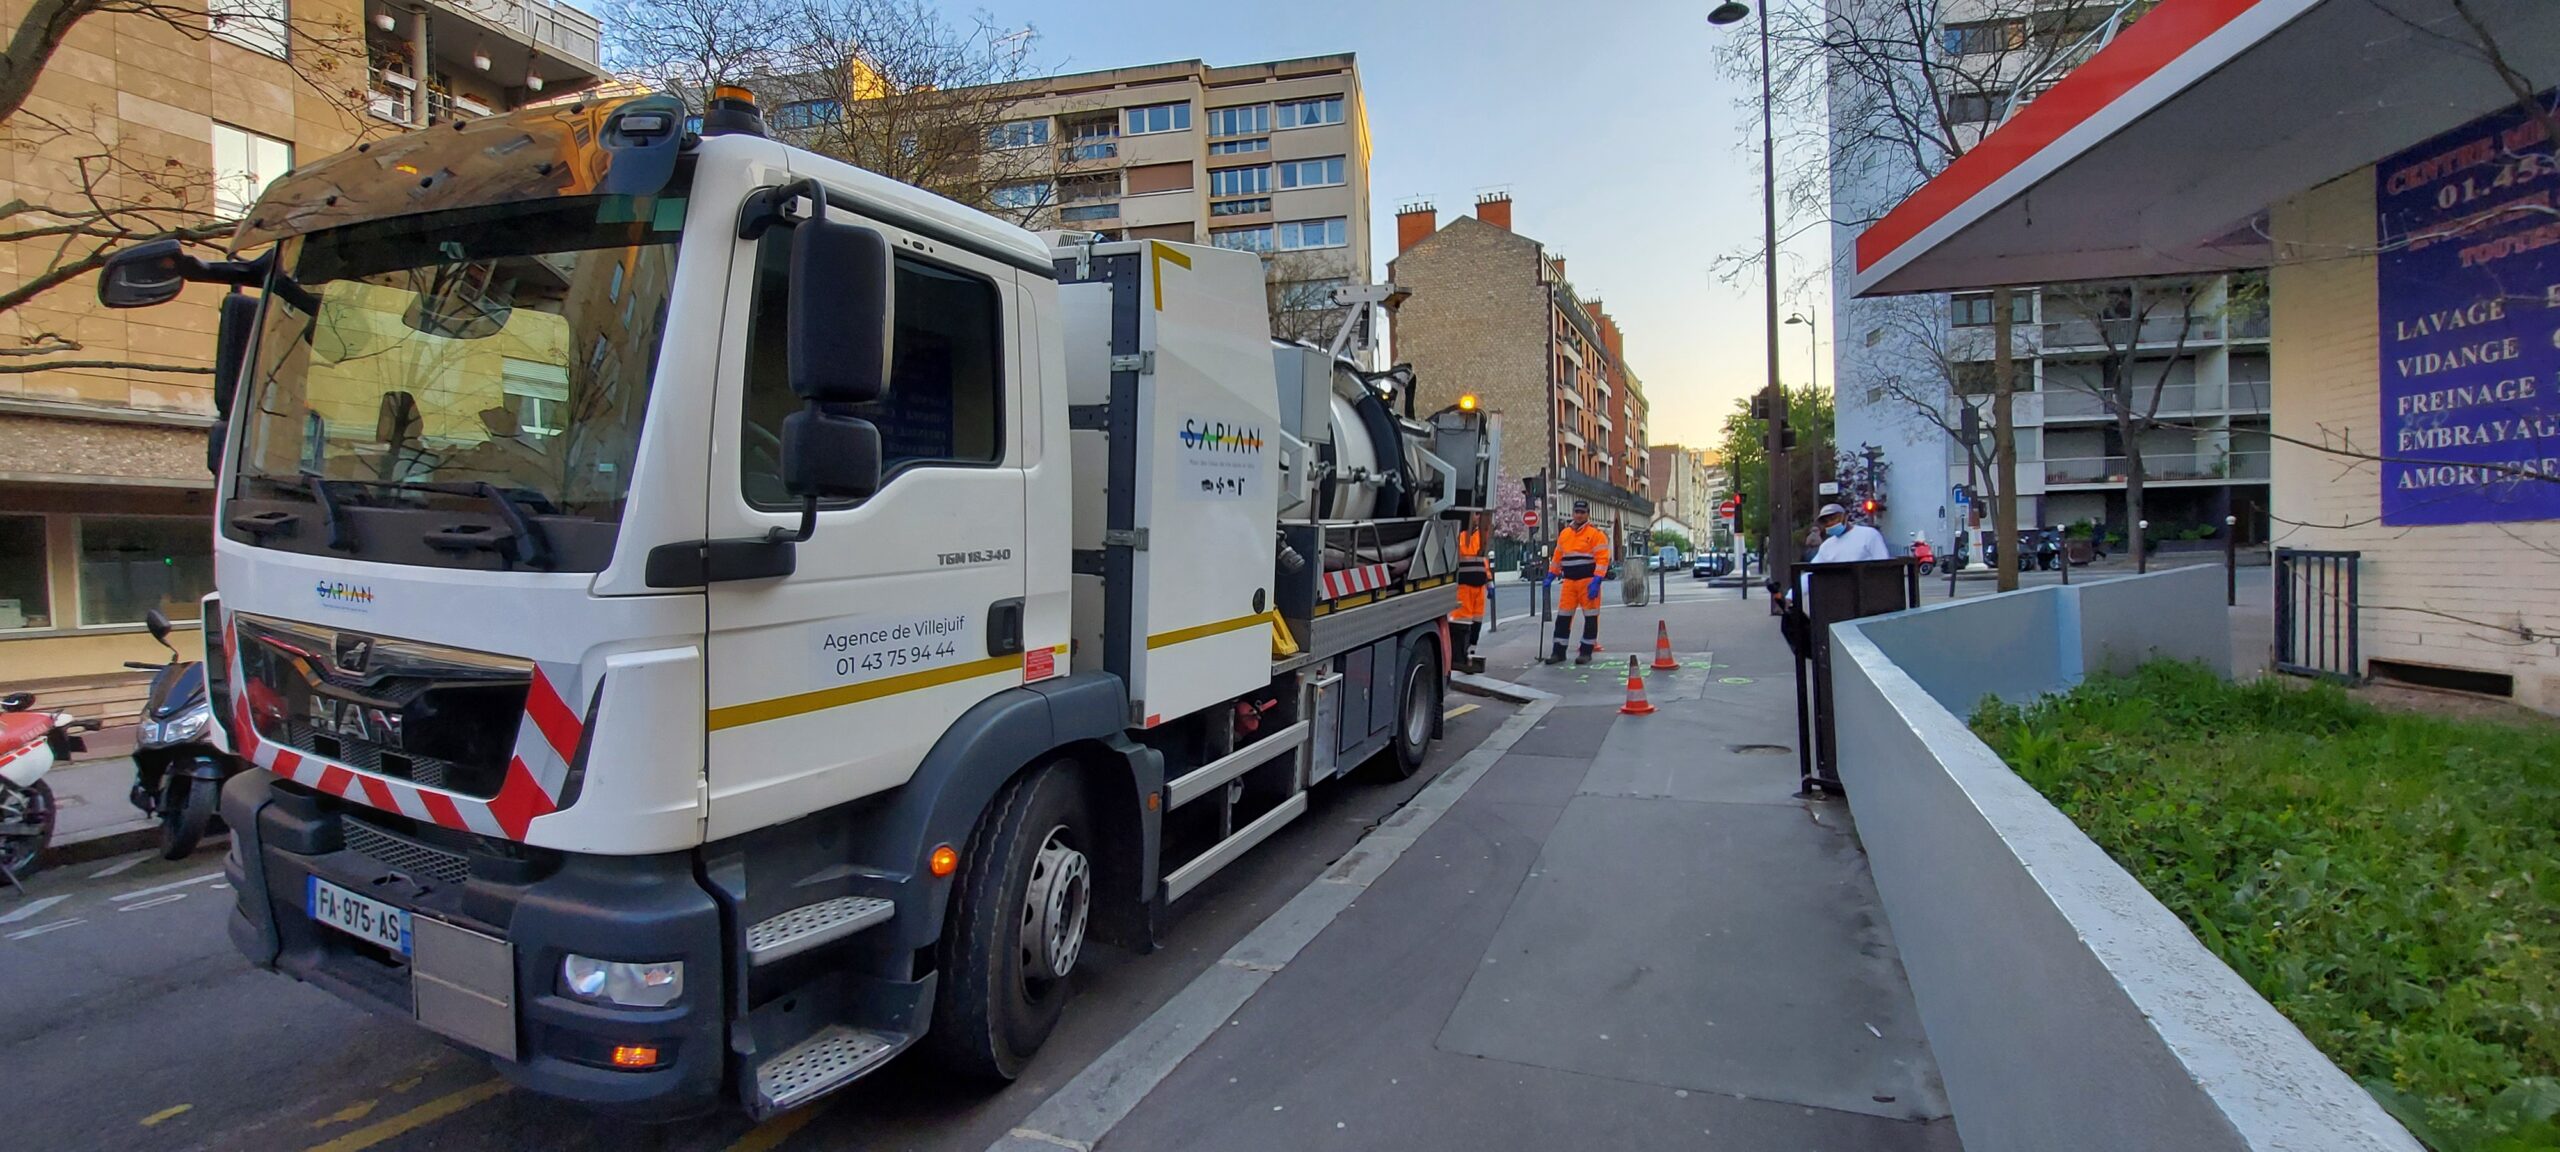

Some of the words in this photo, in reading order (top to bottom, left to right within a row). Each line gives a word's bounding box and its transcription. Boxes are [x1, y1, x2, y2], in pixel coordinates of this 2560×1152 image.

[2388, 137, 2495, 195] CENTRE
[2397, 298, 2506, 341] LAVAGE
[2397, 337, 2519, 377] VIDANGE
[2398, 376, 2536, 416] FREINAGE
[1180, 418, 1263, 454] SAPIAN
[968, 549, 1011, 563] 18.340
[317, 580, 374, 603] SAPIAN
[823, 630, 888, 652] Agence
[892, 624, 911, 640] de
[914, 615, 965, 637] Villejuif
[836, 657, 855, 676] 01
[861, 653, 883, 671] 43
[887, 649, 907, 667] 75
[911, 645, 932, 663] 94
[935, 641, 956, 658] 44
[310, 694, 403, 749] MAN
[320, 887, 399, 942] FA-975-AS
